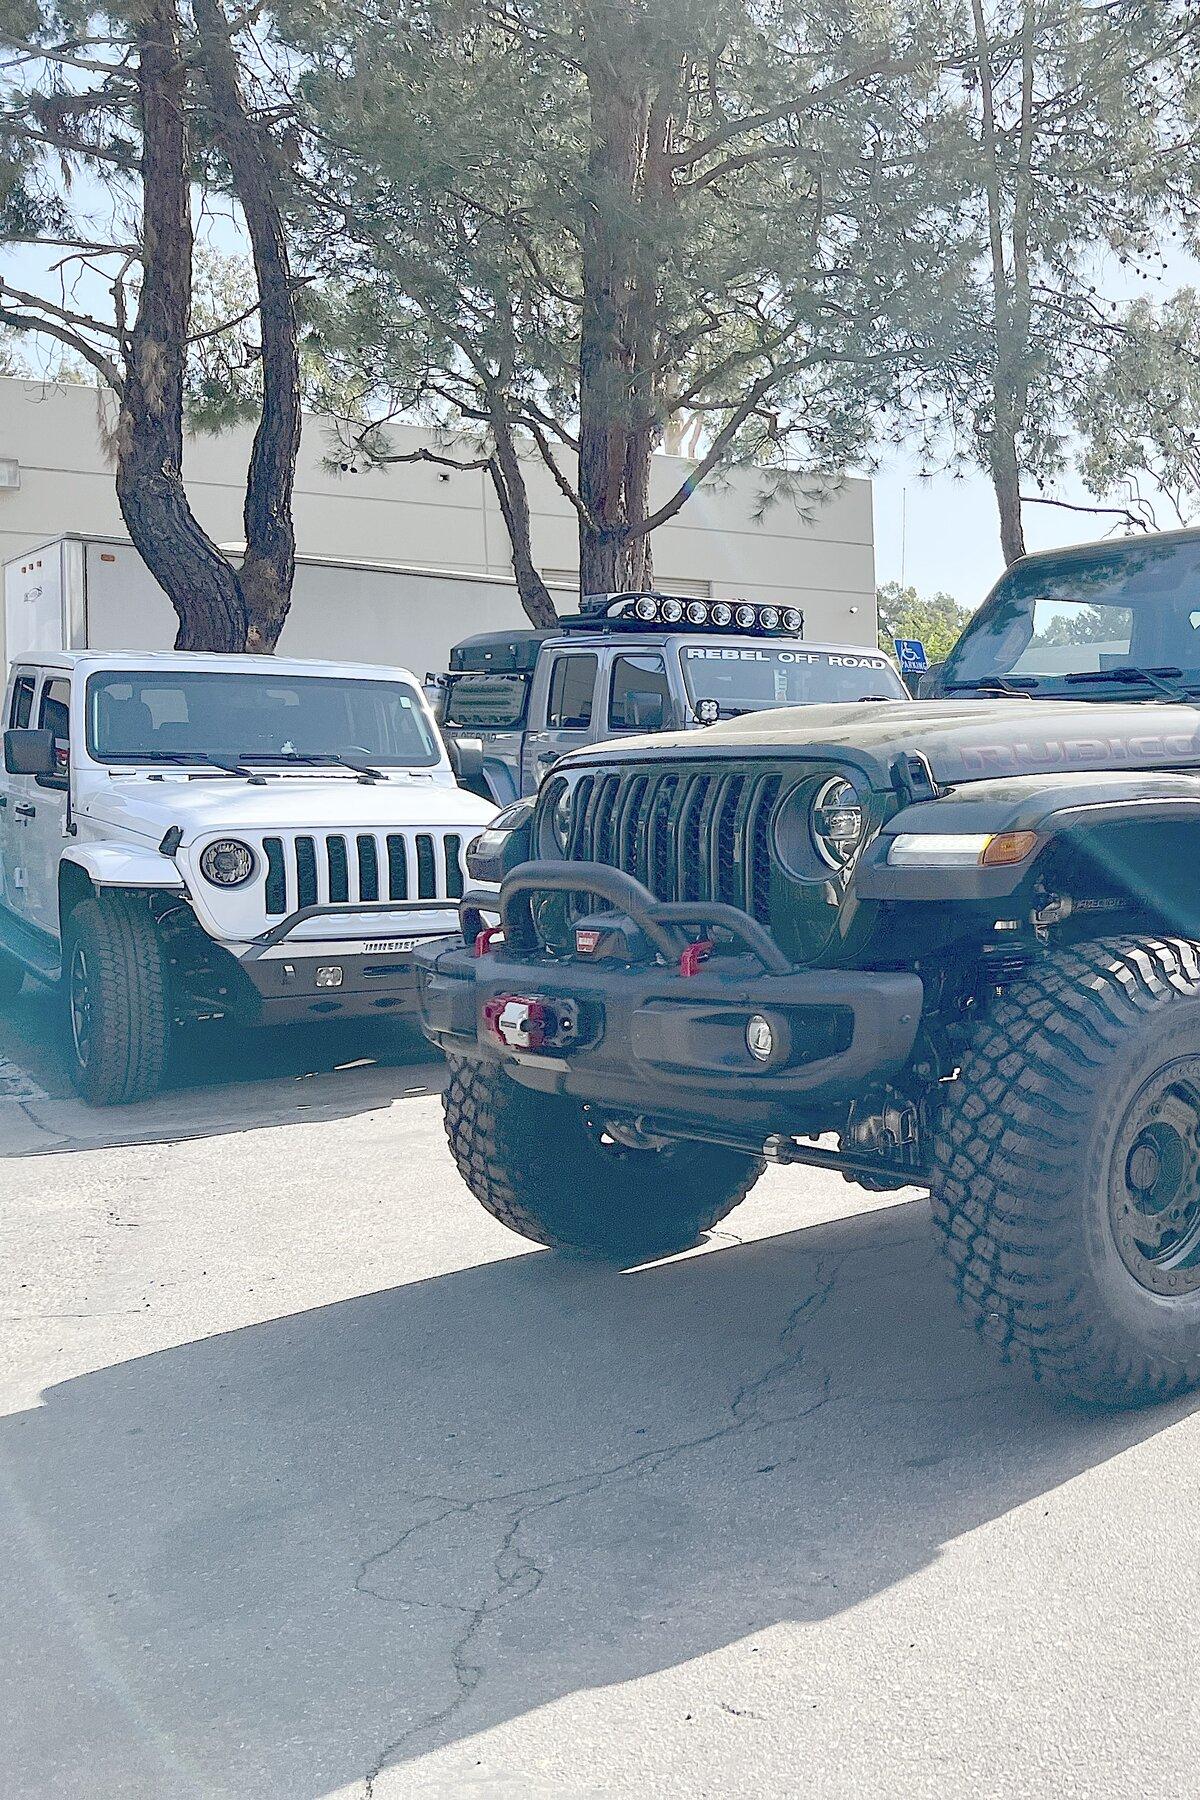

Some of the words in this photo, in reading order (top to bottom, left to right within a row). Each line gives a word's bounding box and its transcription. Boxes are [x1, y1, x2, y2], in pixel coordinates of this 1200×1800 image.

[686, 648, 771, 662] REBEL
[777, 652, 820, 664] OFF
[828, 656, 886, 670] ROAD
